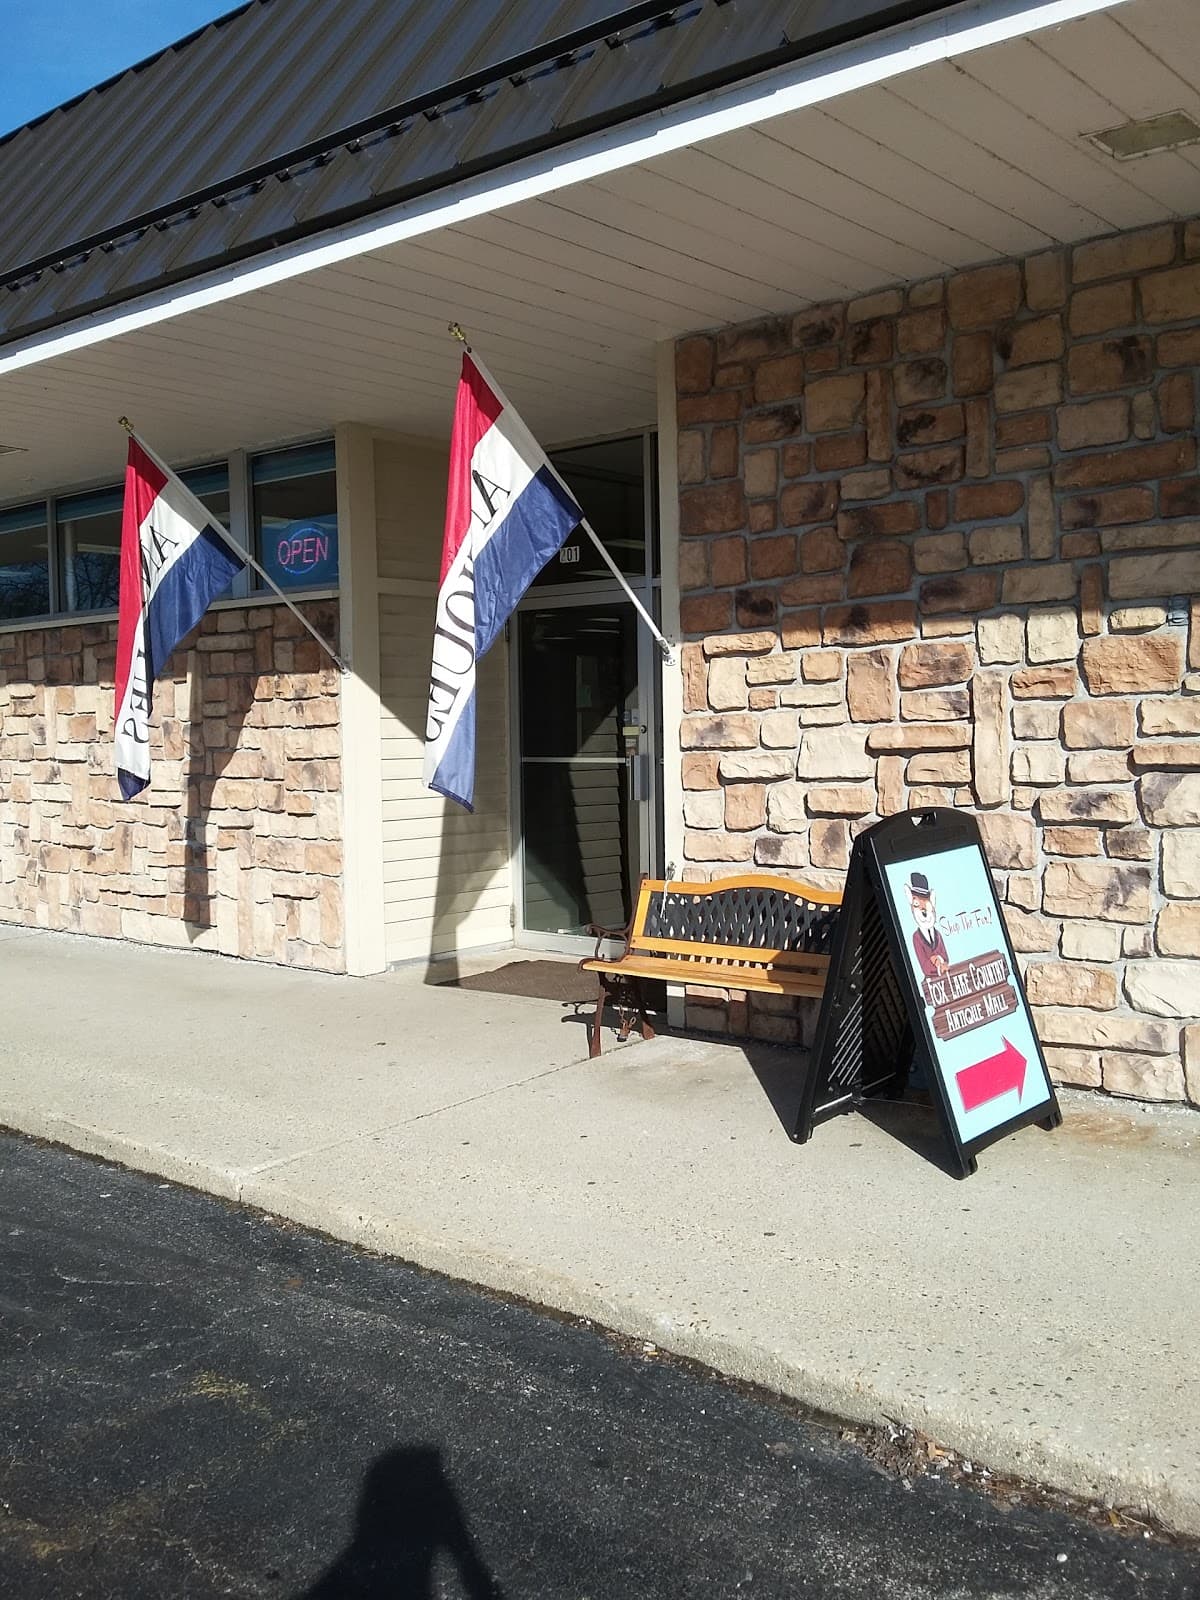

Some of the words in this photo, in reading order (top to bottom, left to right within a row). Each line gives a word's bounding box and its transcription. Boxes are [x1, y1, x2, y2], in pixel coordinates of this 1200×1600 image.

[277, 535, 329, 565] OPEN
[940, 916, 960, 937] Shop
[955, 911, 974, 931] The
[970, 906, 992, 928] Fox!
[926, 977, 949, 1007] FOX
[946, 970, 972, 1000] LAKE
[968, 959, 1007, 990] COUNTRY
[945, 1003, 985, 1033] ANTIQUE
[983, 992, 1009, 1017] MALL
